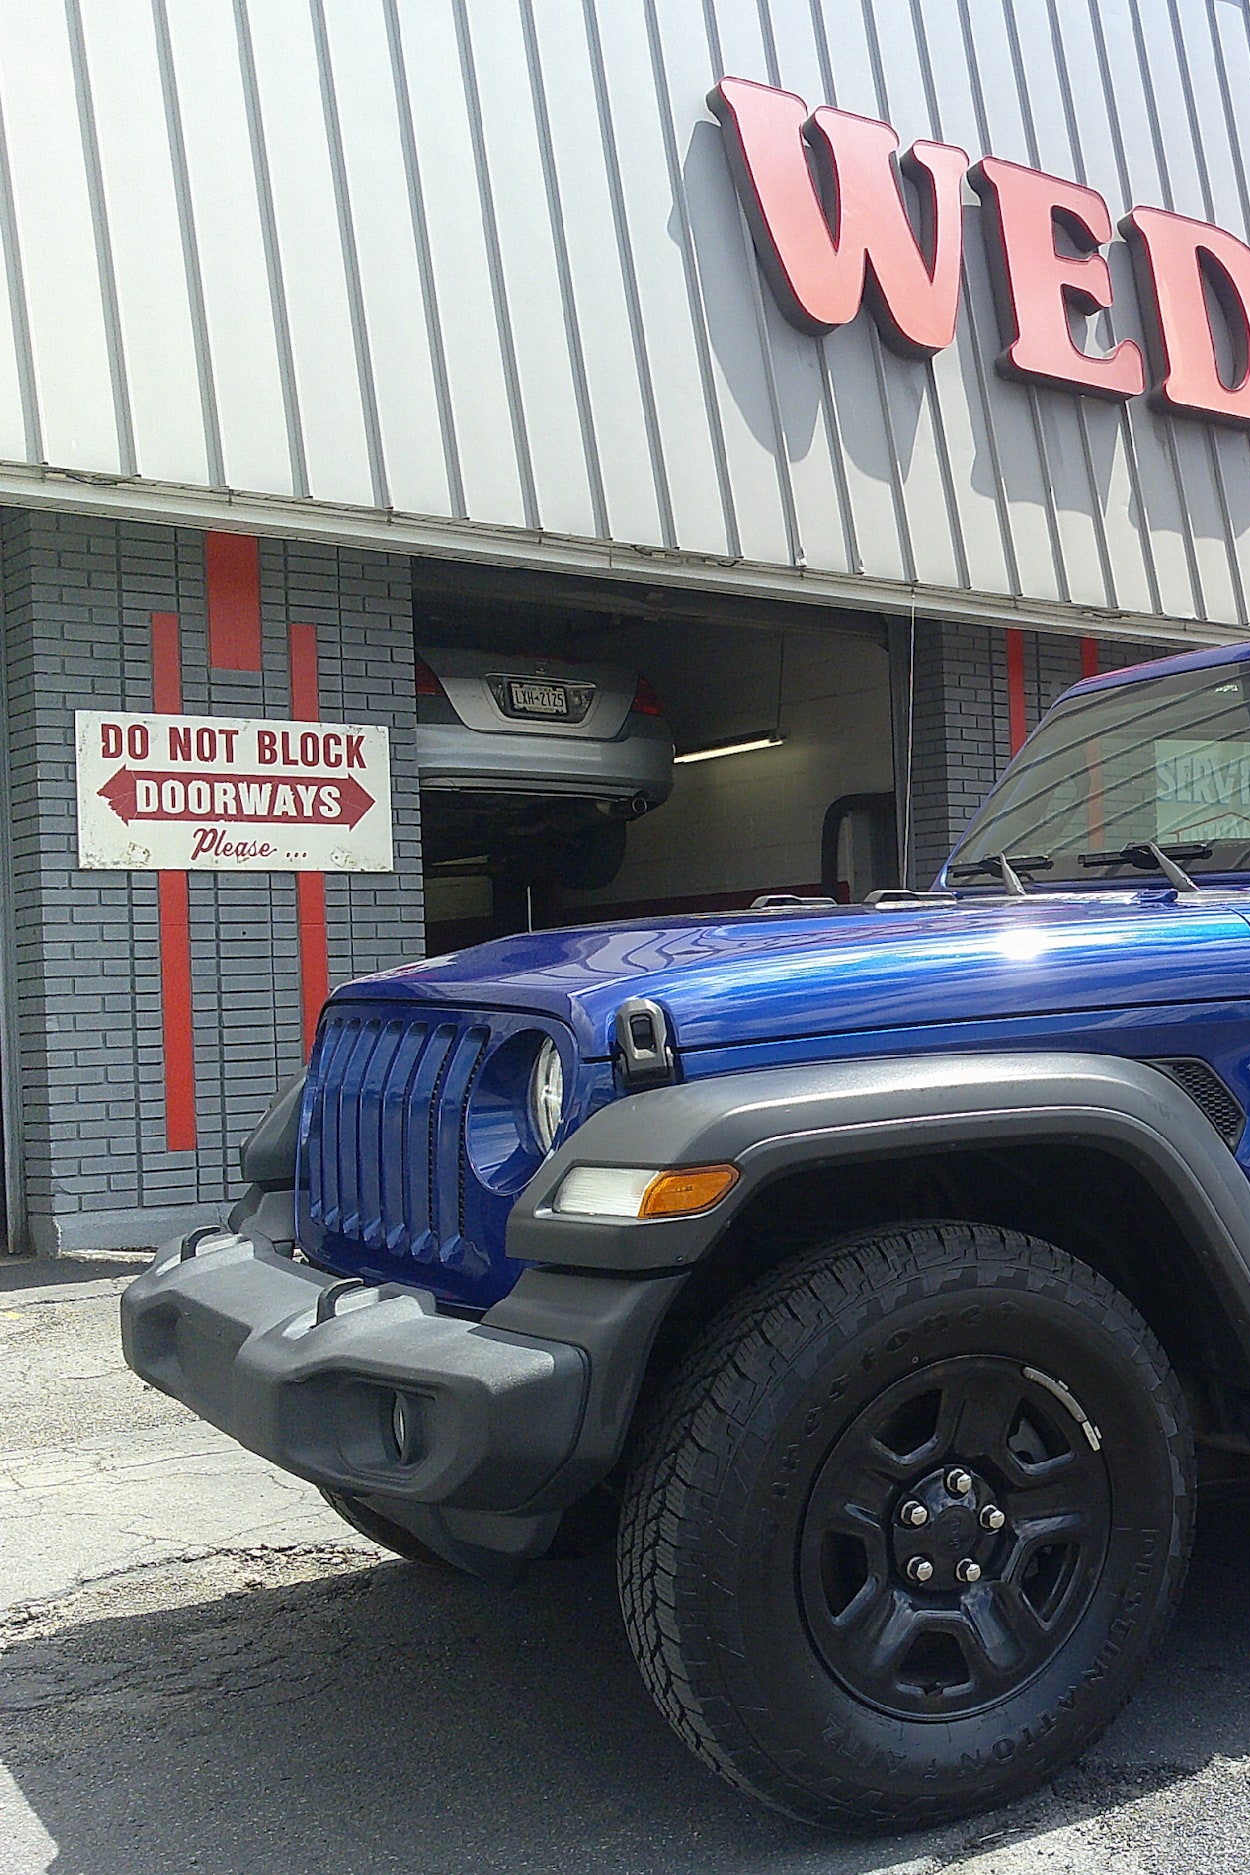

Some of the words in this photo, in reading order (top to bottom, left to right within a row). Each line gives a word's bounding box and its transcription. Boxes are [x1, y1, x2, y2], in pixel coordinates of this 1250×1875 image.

[101, 723, 149, 760] DO
[169, 726, 239, 763] NOT
[257, 730, 367, 769] BLOCK
[135, 779, 342, 818] DOORWAYS
[190, 828, 278, 861] Please
